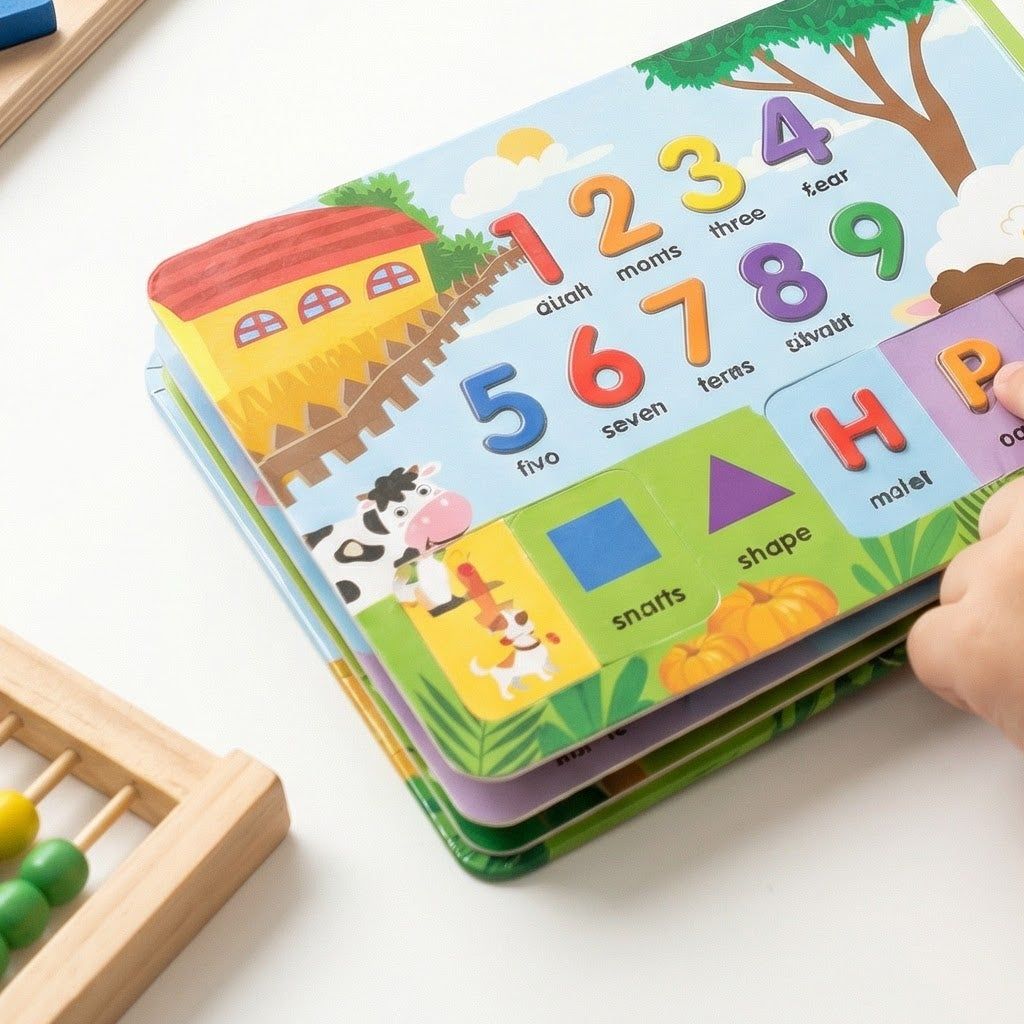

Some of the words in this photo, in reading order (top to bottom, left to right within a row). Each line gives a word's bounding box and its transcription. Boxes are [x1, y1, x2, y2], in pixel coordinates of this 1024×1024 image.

[488, 212, 564, 285] 1
[569, 175, 663, 258] 2
[658, 135, 746, 214] 3
[762, 97, 833, 166] 4
[708, 206, 766, 239] three
[460, 363, 548, 455] 5
[568, 325, 645, 408] 6
[639, 278, 711, 367] 7
[739, 243, 828, 323] 8
[829, 202, 904, 281] 9
[601, 399, 668, 440] seven
[810, 389, 909, 472] H
[935, 338, 1002, 414] P
[738, 523, 812, 572] shape
